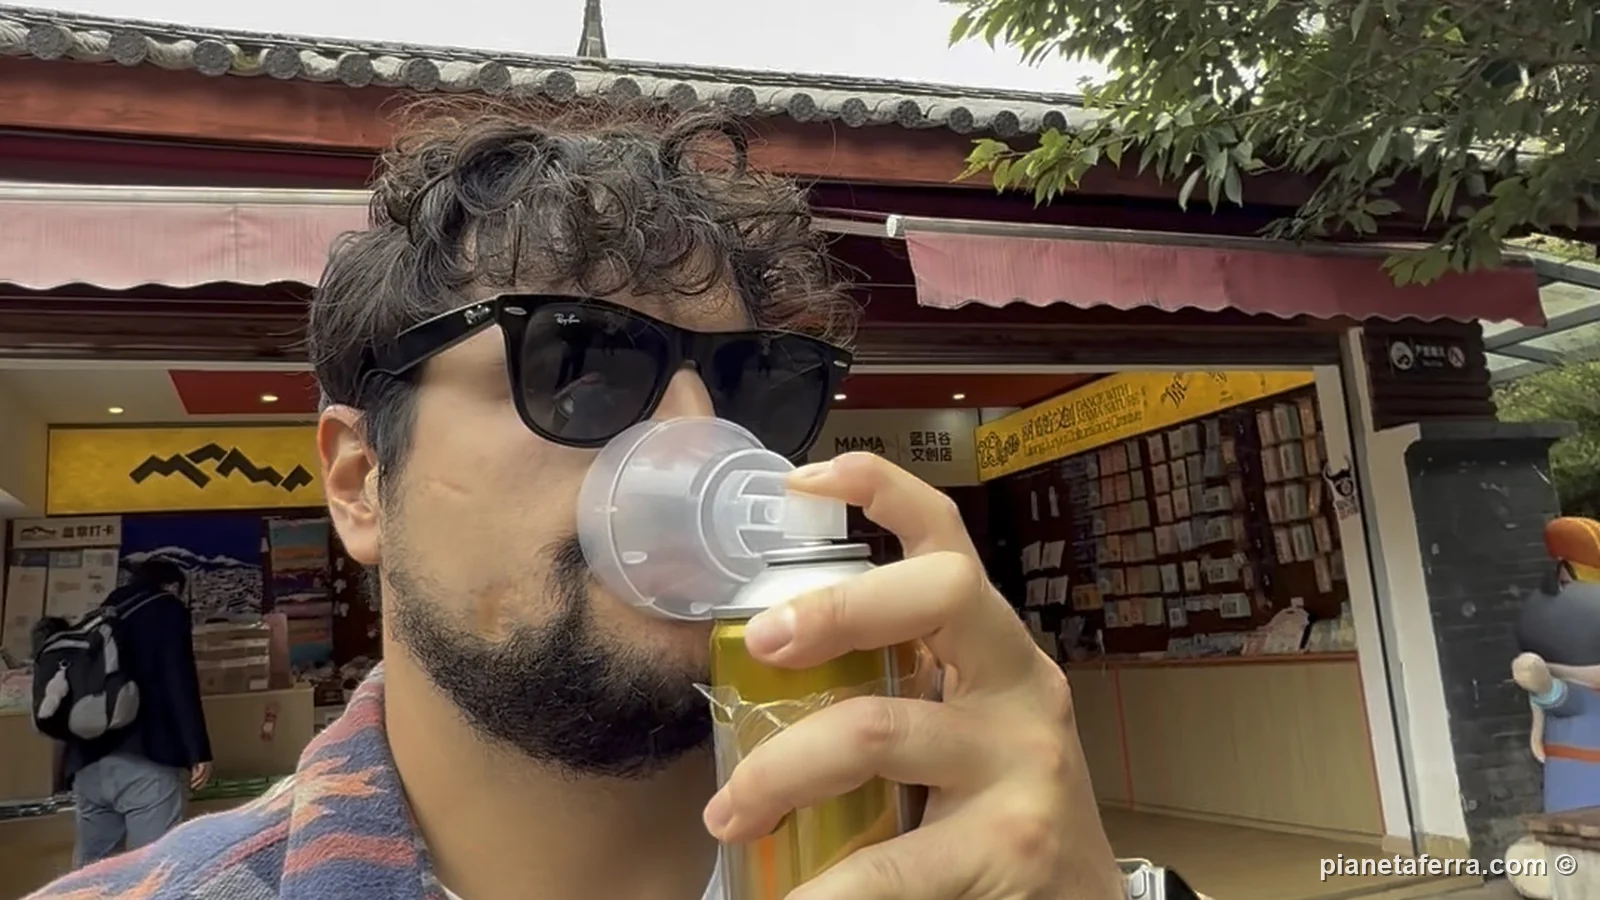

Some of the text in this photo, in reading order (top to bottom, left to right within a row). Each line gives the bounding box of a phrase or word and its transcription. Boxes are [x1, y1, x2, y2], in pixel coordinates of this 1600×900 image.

[834, 436, 885, 451] MAMA
[909, 431, 951, 446] 蓝月谷
[911, 447, 953, 462] 文创店
